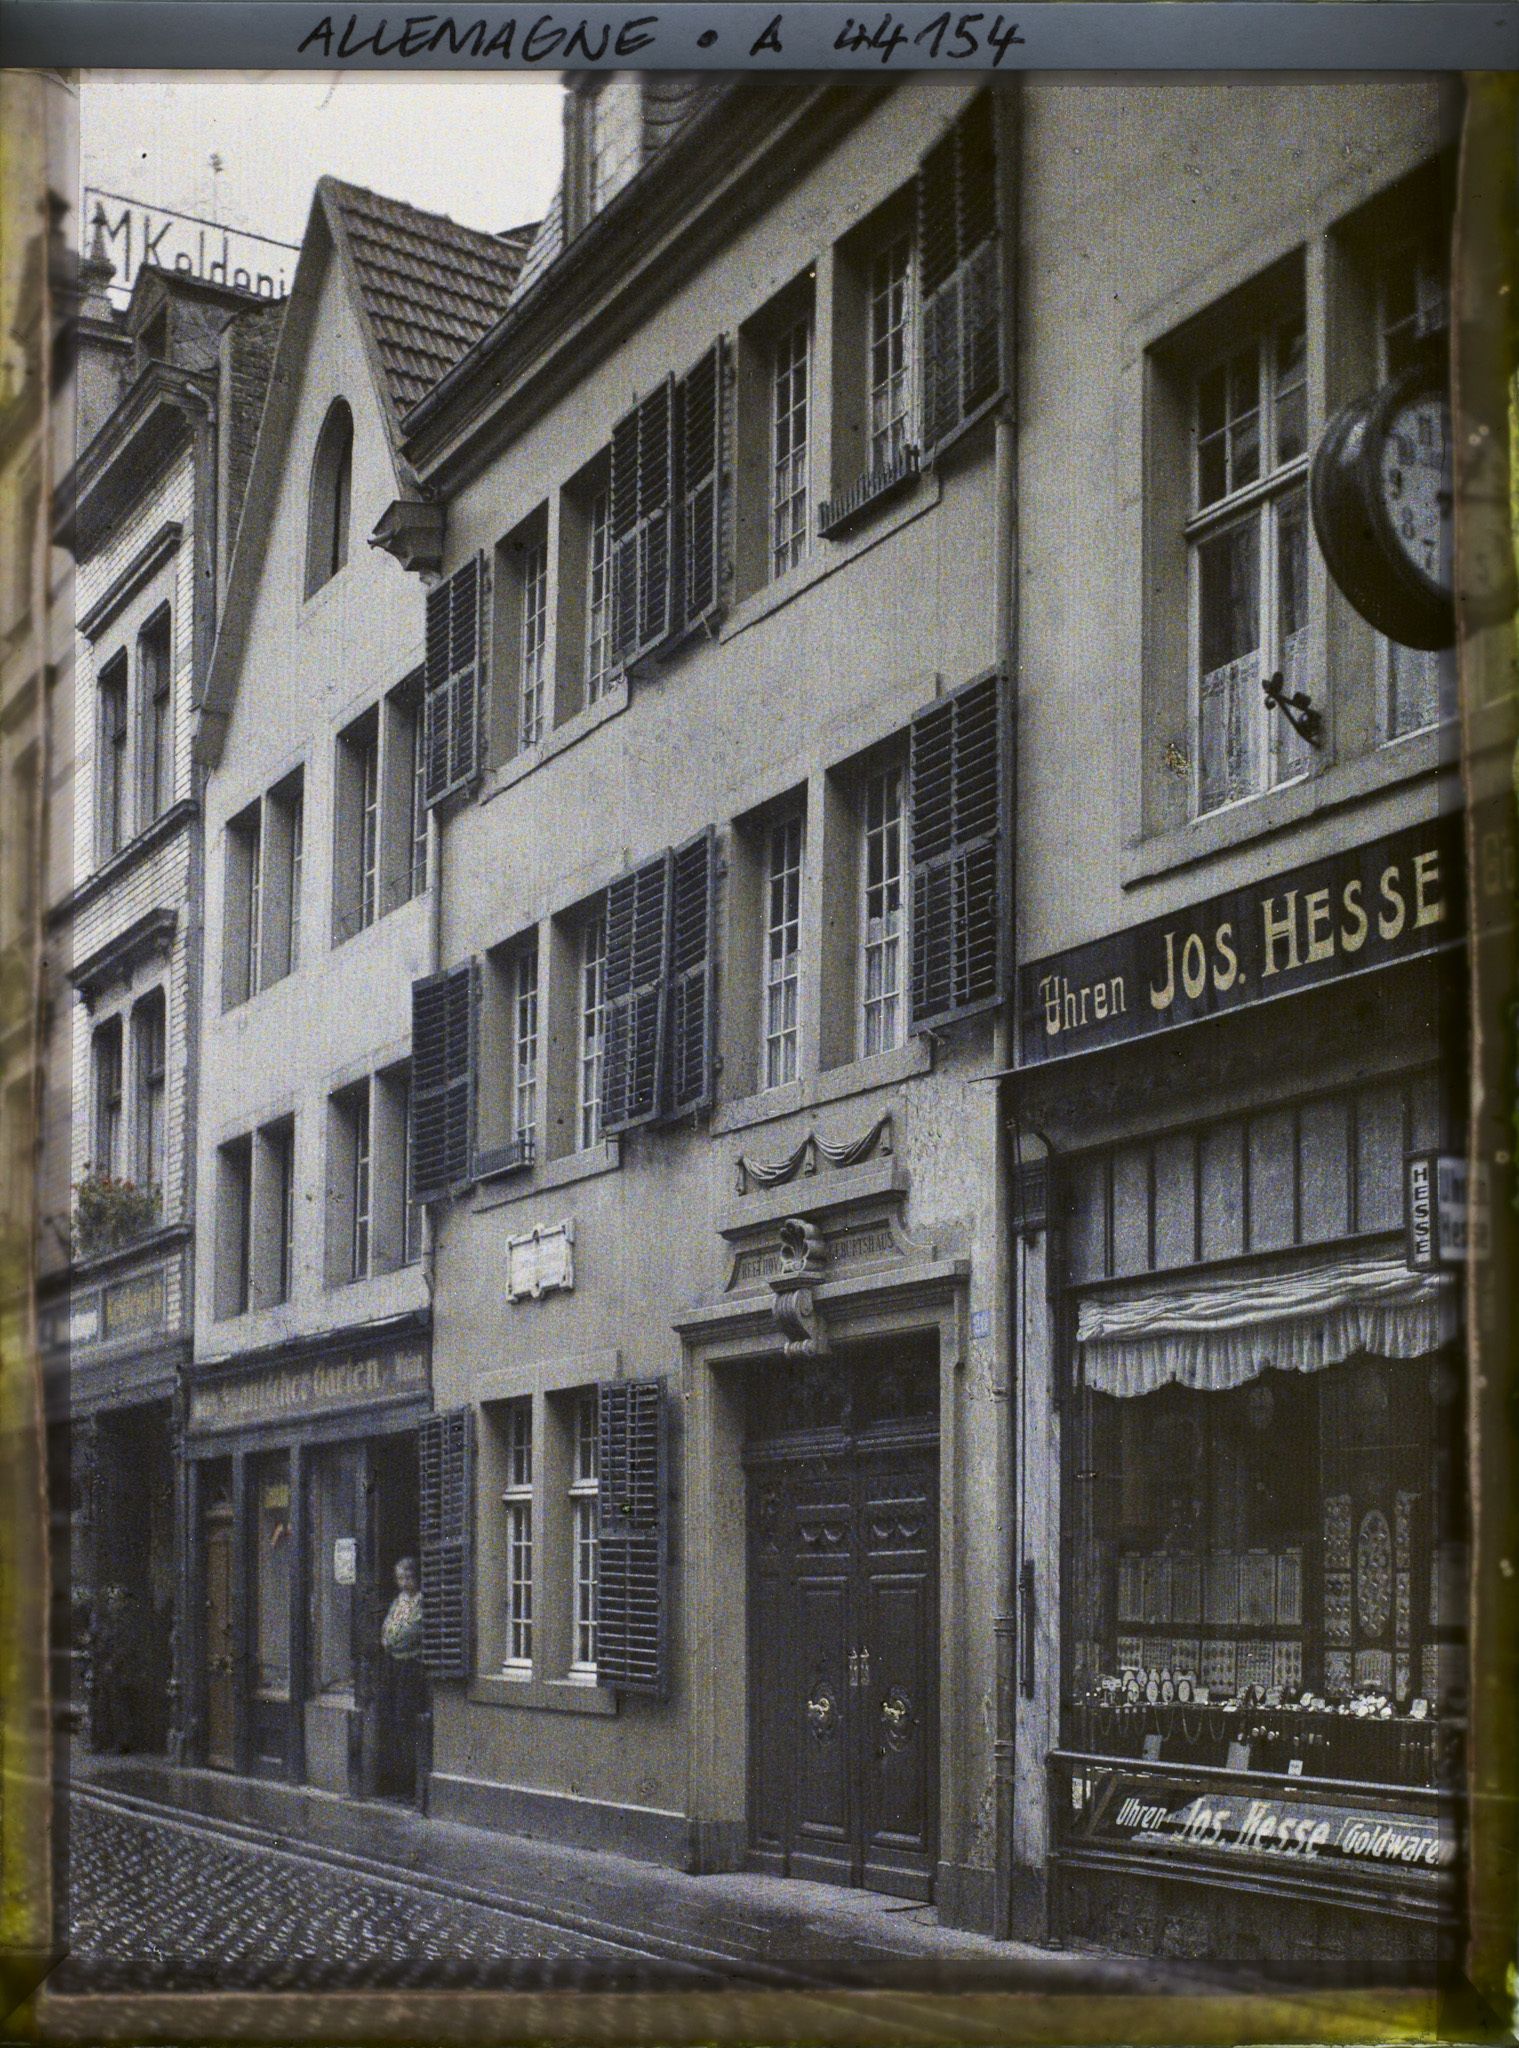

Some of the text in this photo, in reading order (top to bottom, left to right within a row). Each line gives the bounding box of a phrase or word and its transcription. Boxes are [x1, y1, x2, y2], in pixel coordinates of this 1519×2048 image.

[297, 12, 1026, 68] ALLEMAGNE A 44154
[1401, 505, 1416, 541] 8
[1039, 975, 1127, 1035] Uhren
[1261, 849, 1446, 977] HESSE
[1413, 1167, 1430, 1255] HESSE
[1235, 1801, 1331, 1858] Hesse
